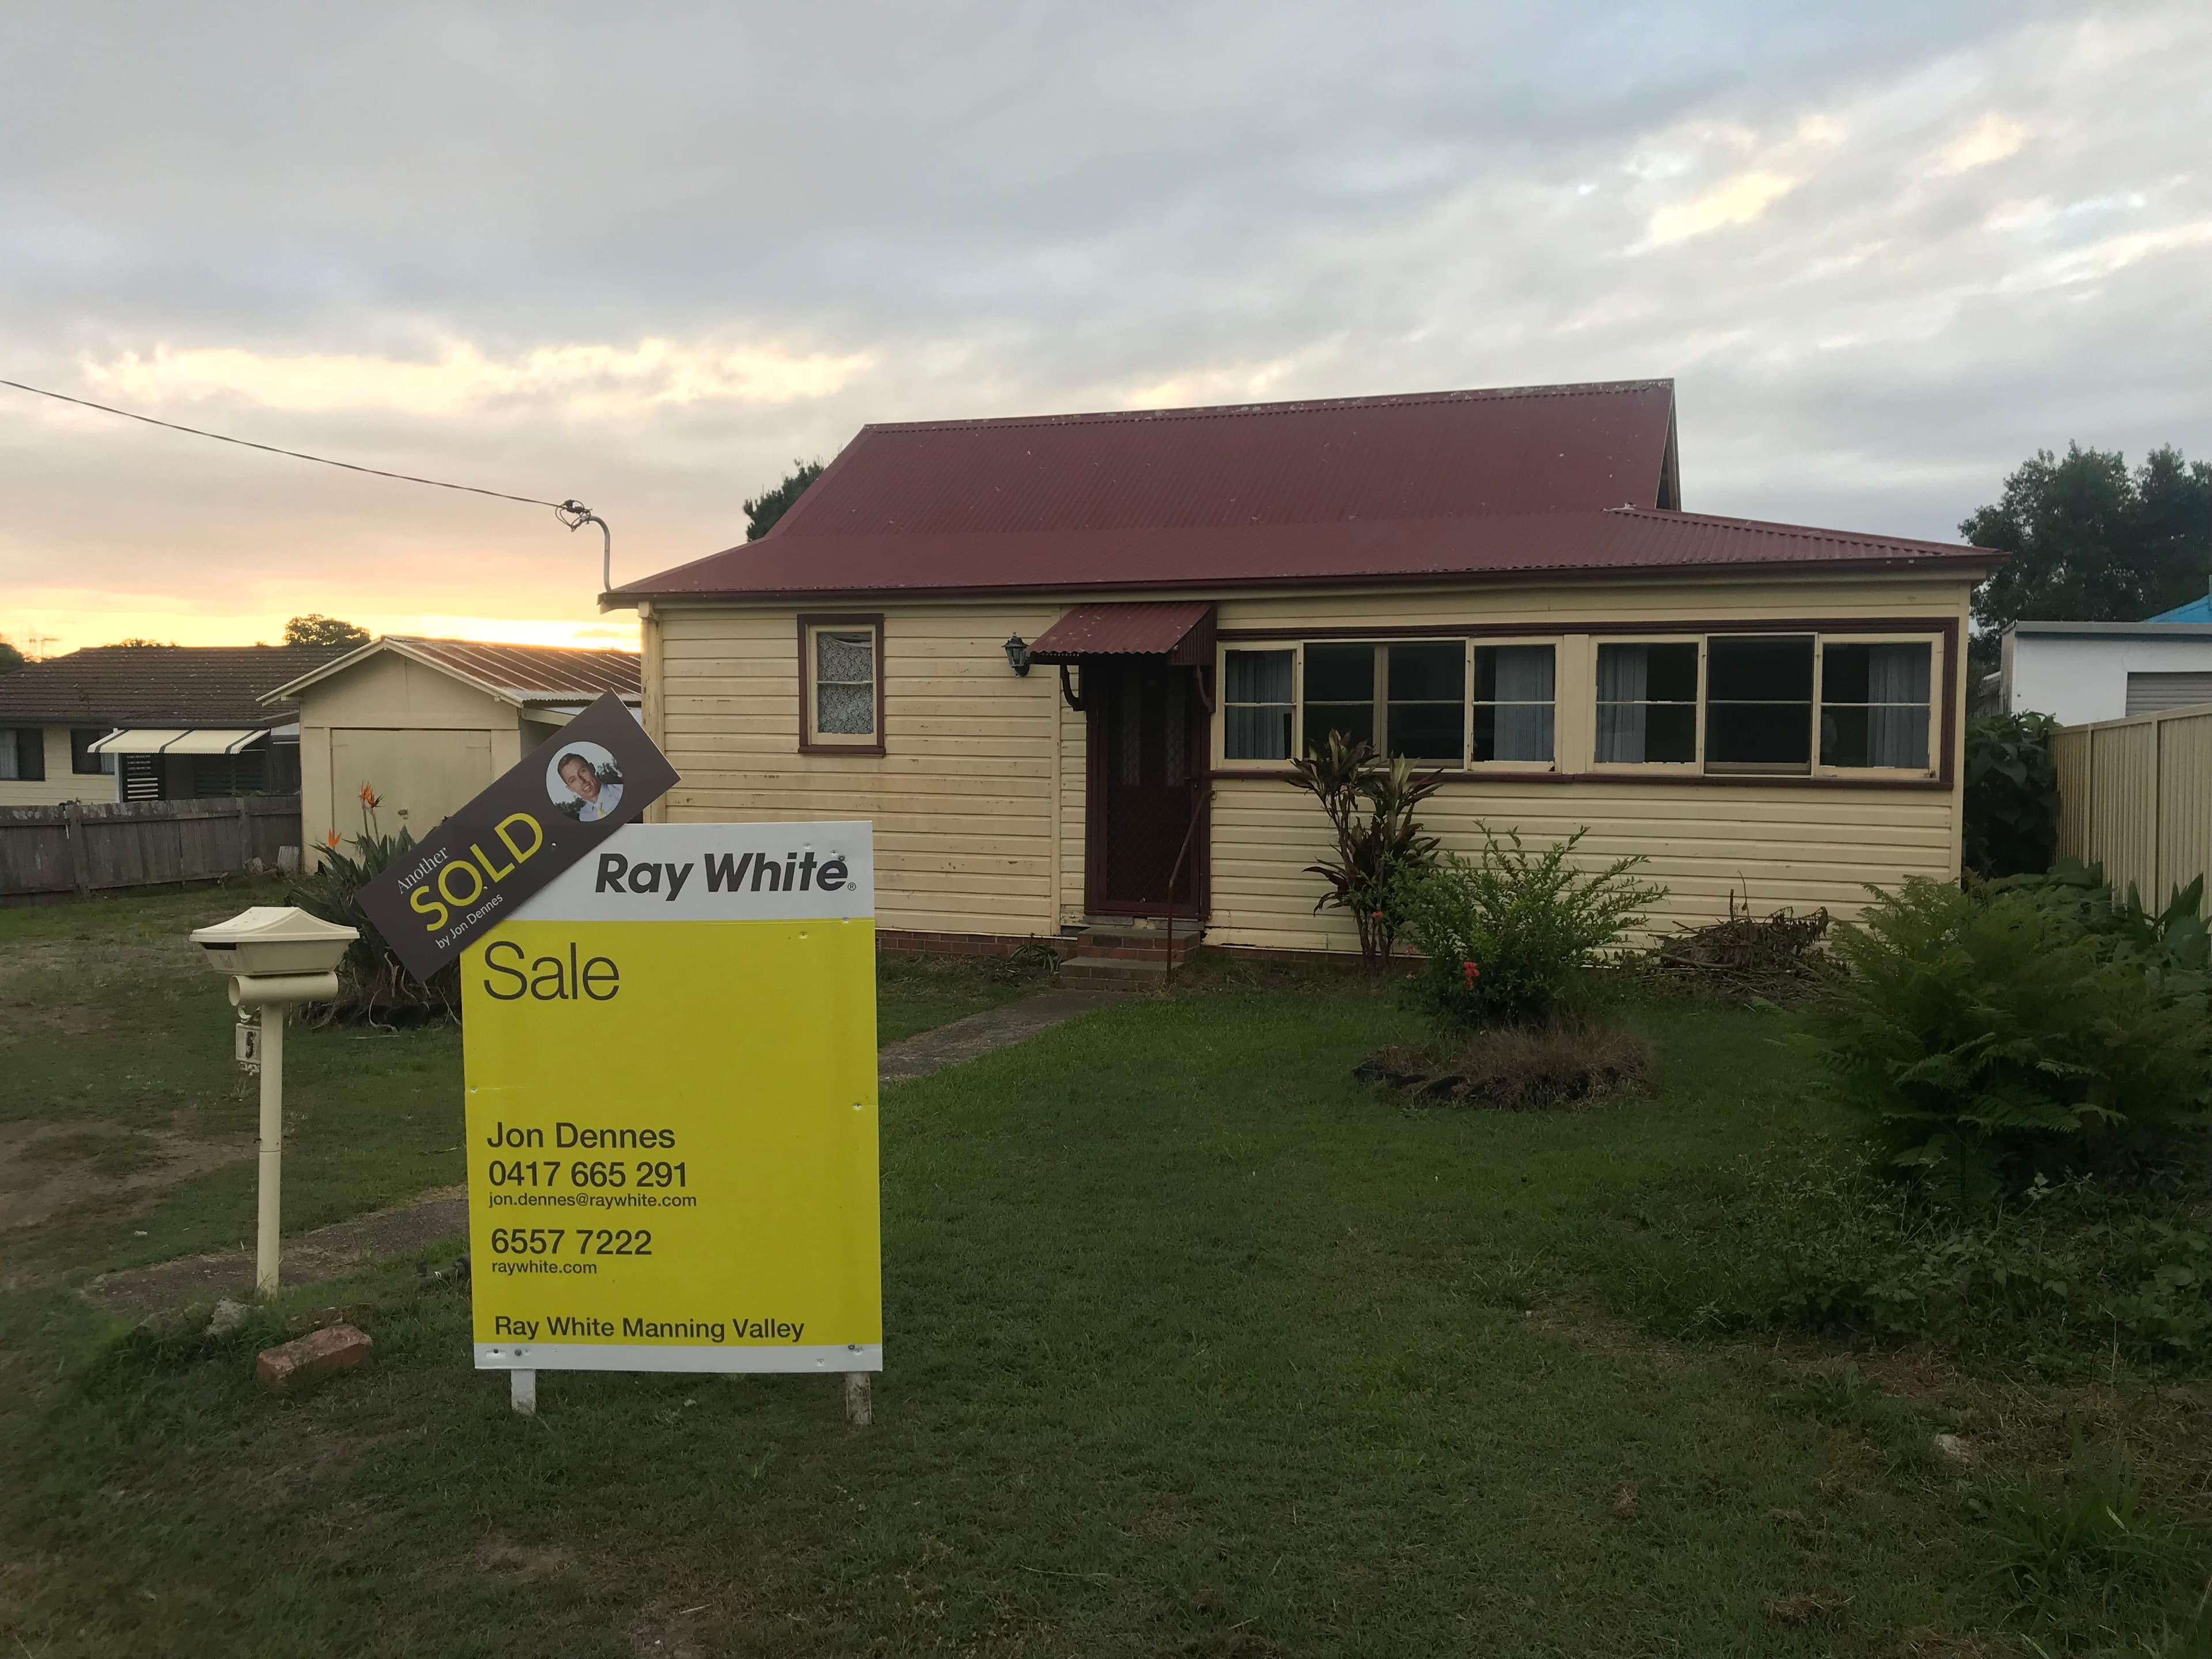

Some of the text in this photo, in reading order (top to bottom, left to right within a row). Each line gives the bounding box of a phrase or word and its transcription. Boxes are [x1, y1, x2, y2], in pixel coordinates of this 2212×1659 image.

[397, 847, 449, 895] Another
[410, 812, 543, 931] SOLD
[595, 853, 694, 902] Ray
[435, 893, 503, 949] by Jon Dennes
[483, 941, 620, 1001] Sale
[487, 1122, 676, 1149] Jon Dennes
[488, 1161, 687, 1188] 0417 665 291
[488, 1192, 697, 1210] jon.dennes@raywhite.com
[491, 1229, 652, 1255] 6557 7222
[492, 1259, 597, 1277] raywhite.com
[495, 1316, 805, 1343] Ray White Manning Valley
